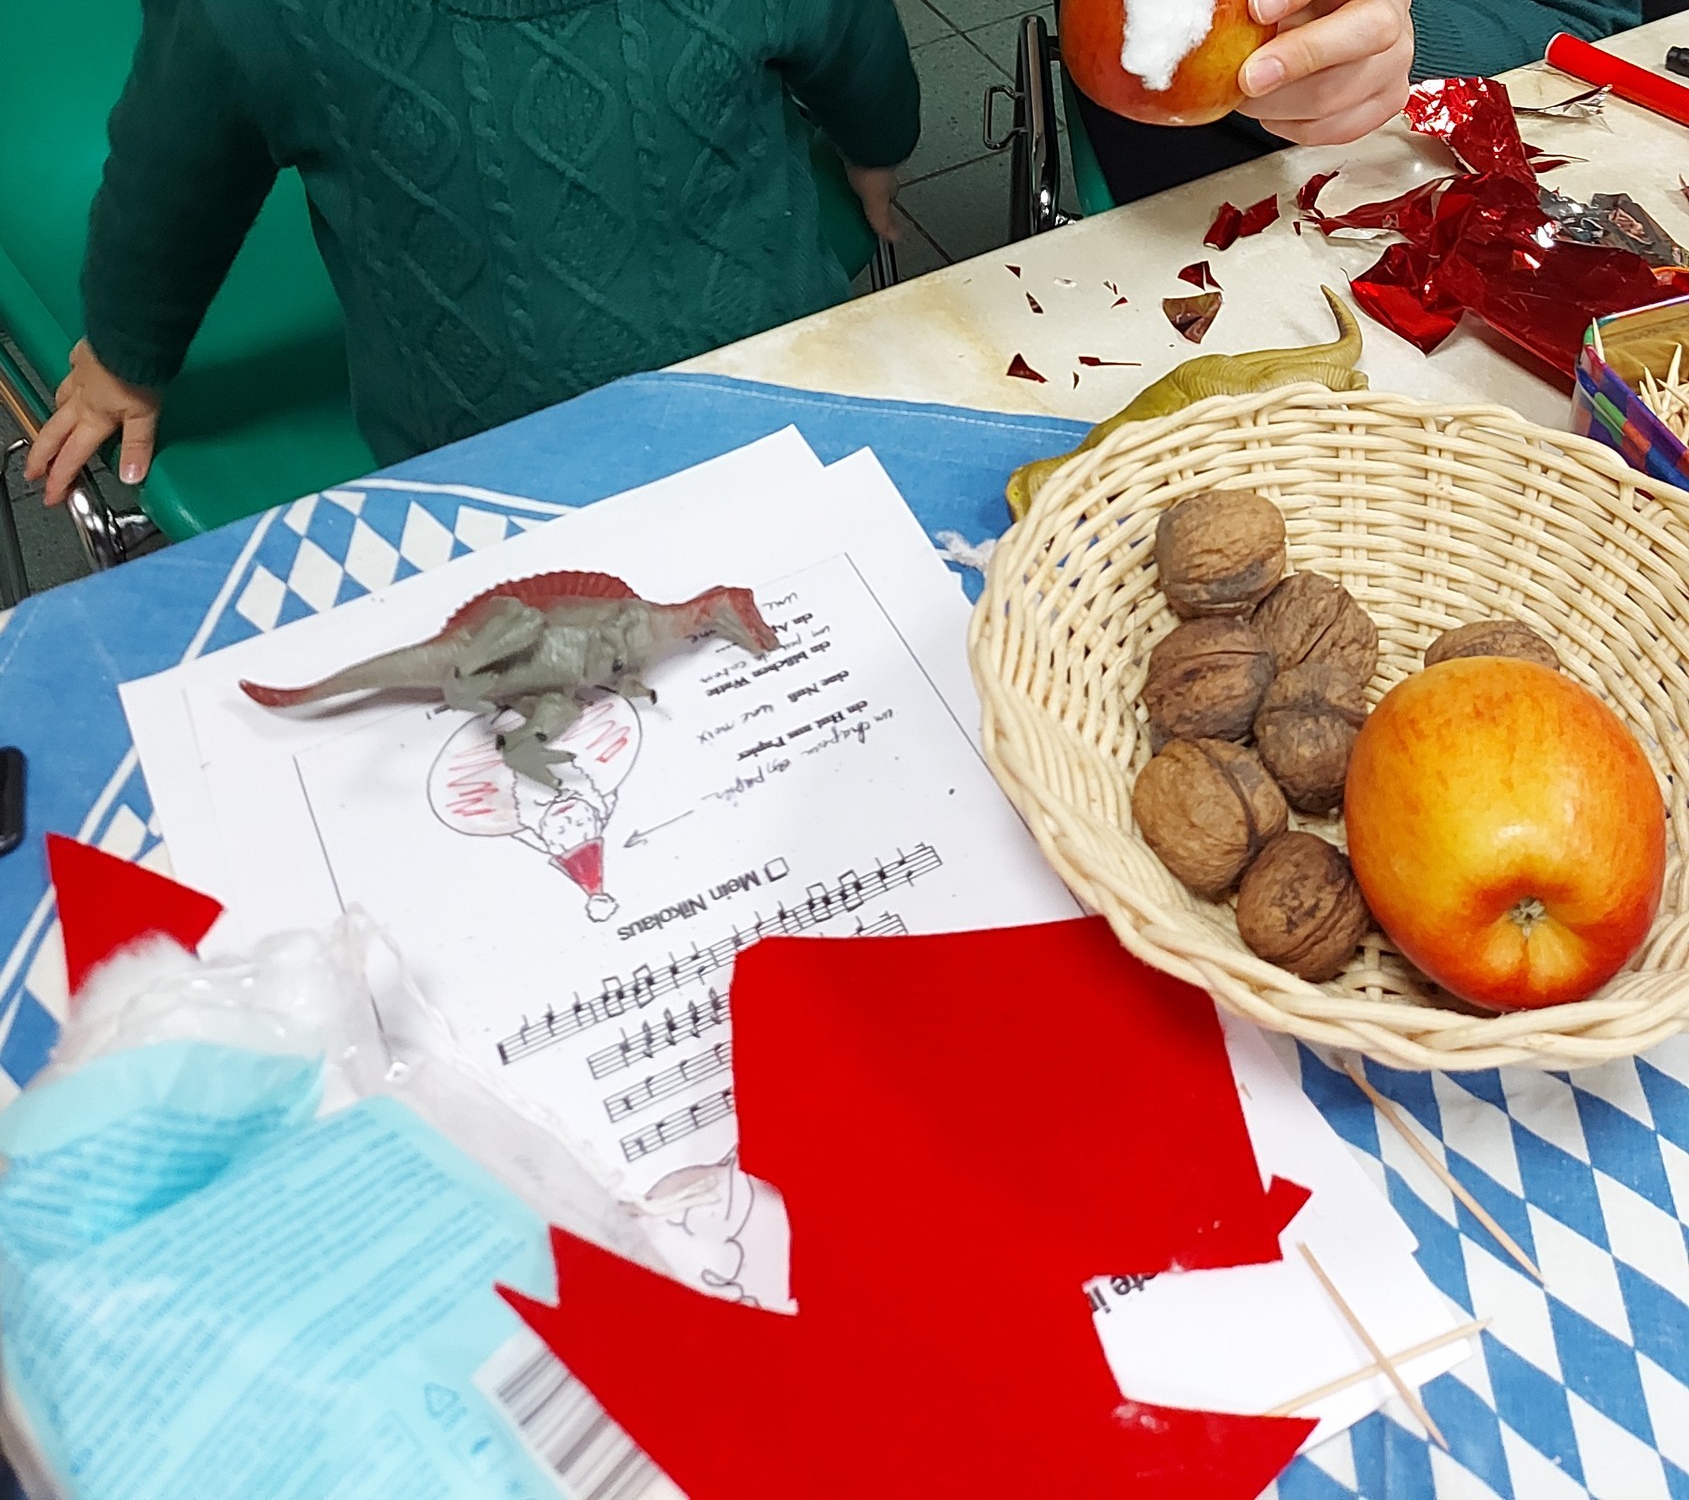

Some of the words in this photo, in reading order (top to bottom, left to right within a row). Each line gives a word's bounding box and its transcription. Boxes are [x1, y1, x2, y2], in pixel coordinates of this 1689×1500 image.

[792, 612, 813, 627] ein
[809, 640, 831, 654] ein
[705, 676, 750, 698] Watte
[820, 670, 849, 687] eine
[846, 700, 868, 716] ein
[815, 710, 845, 729] Hut
[787, 724, 812, 740] aus
[736, 735, 785, 762] Papier
[708, 870, 762, 900] Mein
[616, 894, 709, 941] Nikolaus
[1110, 1272, 1159, 1296] te
